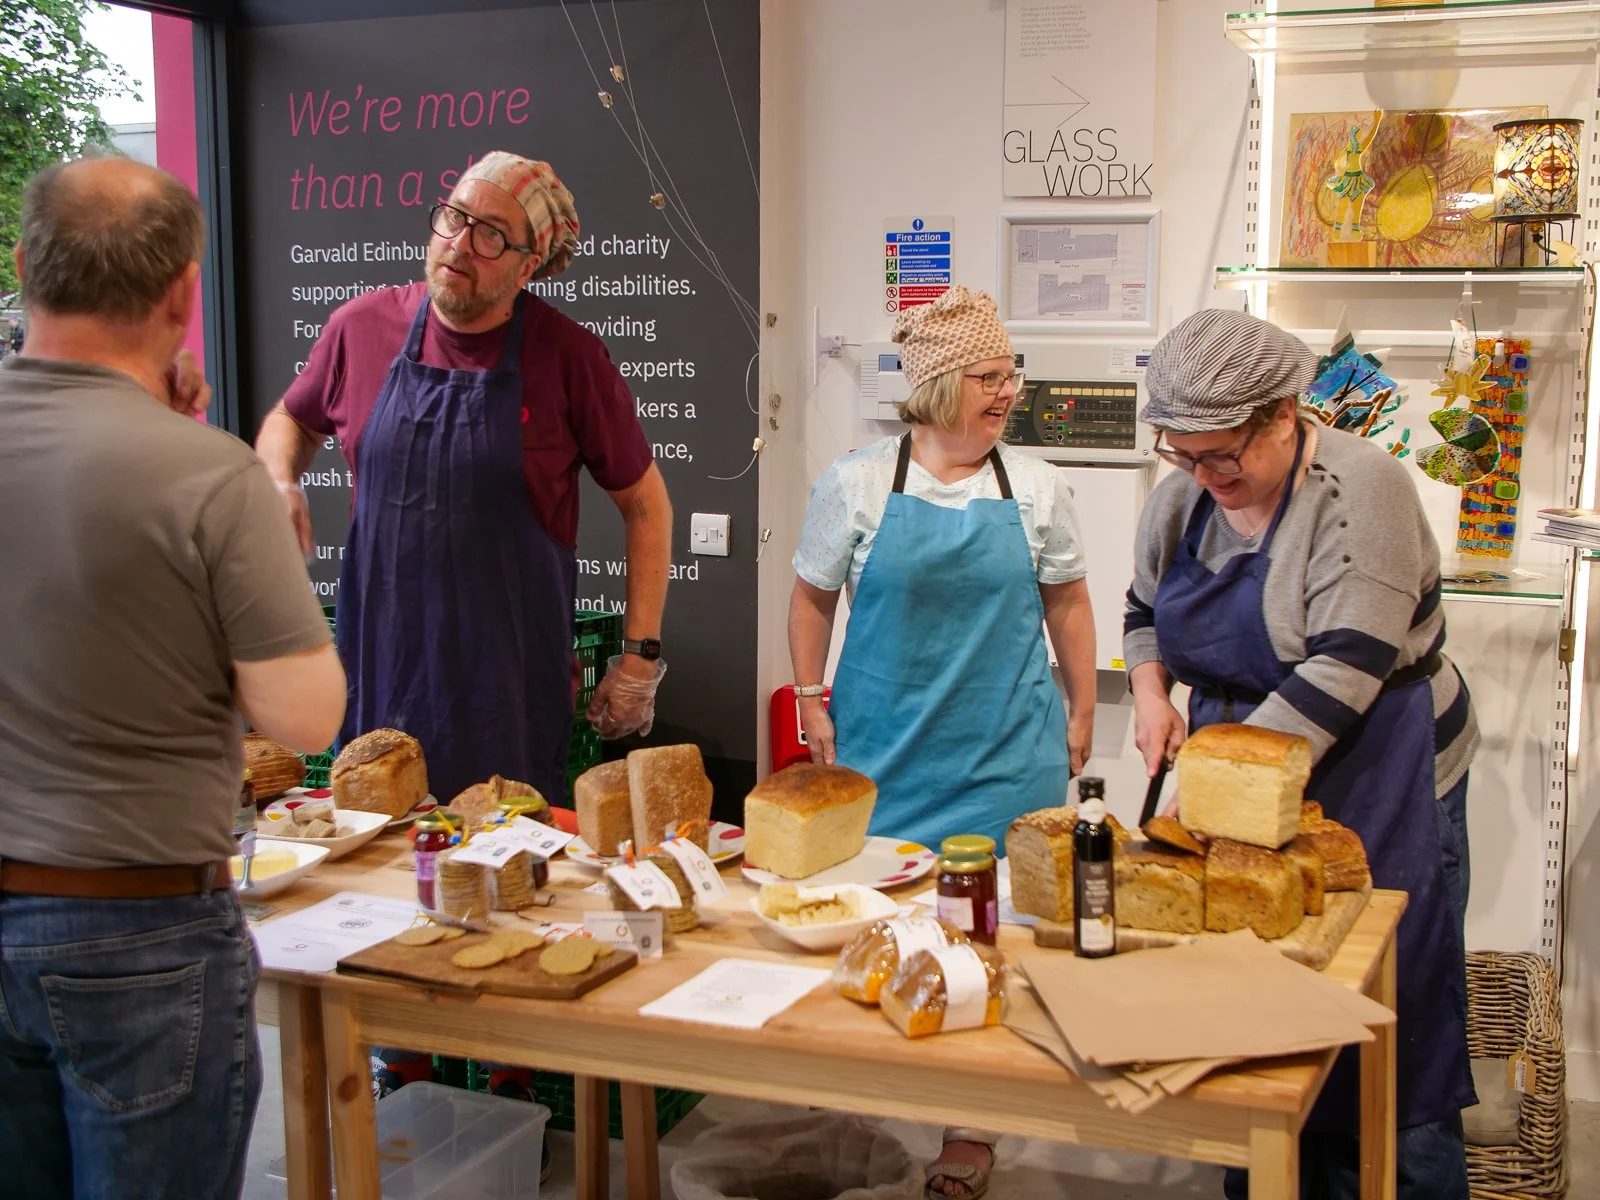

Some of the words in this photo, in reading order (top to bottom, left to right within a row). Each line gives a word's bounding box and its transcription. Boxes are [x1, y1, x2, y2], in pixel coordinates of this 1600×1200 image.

[289, 84, 402, 137] We're
[416, 87, 531, 130] more
[1002, 127, 1118, 164] GLASS
[289, 163, 384, 210] than
[398, 171, 424, 207] a
[1042, 163, 1154, 197] WORK
[291, 242, 358, 264] Garvald
[573, 233, 595, 257] ed
[600, 233, 671, 260] charity
[896, 233, 913, 242] Fire
[914, 233, 941, 242] action
[523, 276, 577, 302] rning
[581, 275, 697, 297] disabilities.
[293, 320, 321, 339] For
[577, 315, 657, 342] roviding
[620, 358, 696, 383] experts
[636, 397, 679, 419] kers
[684, 402, 697, 419] a
[323, 436, 334, 450] e
[652, 443, 693, 463] nce,
[300, 467, 341, 489] push
[345, 470, 353, 487] t
[316, 545, 334, 560] ur
[576, 558, 601, 575] ms
[606, 556, 627, 577] wi
[668, 560, 699, 581] ard
[610, 601, 627, 615] w
